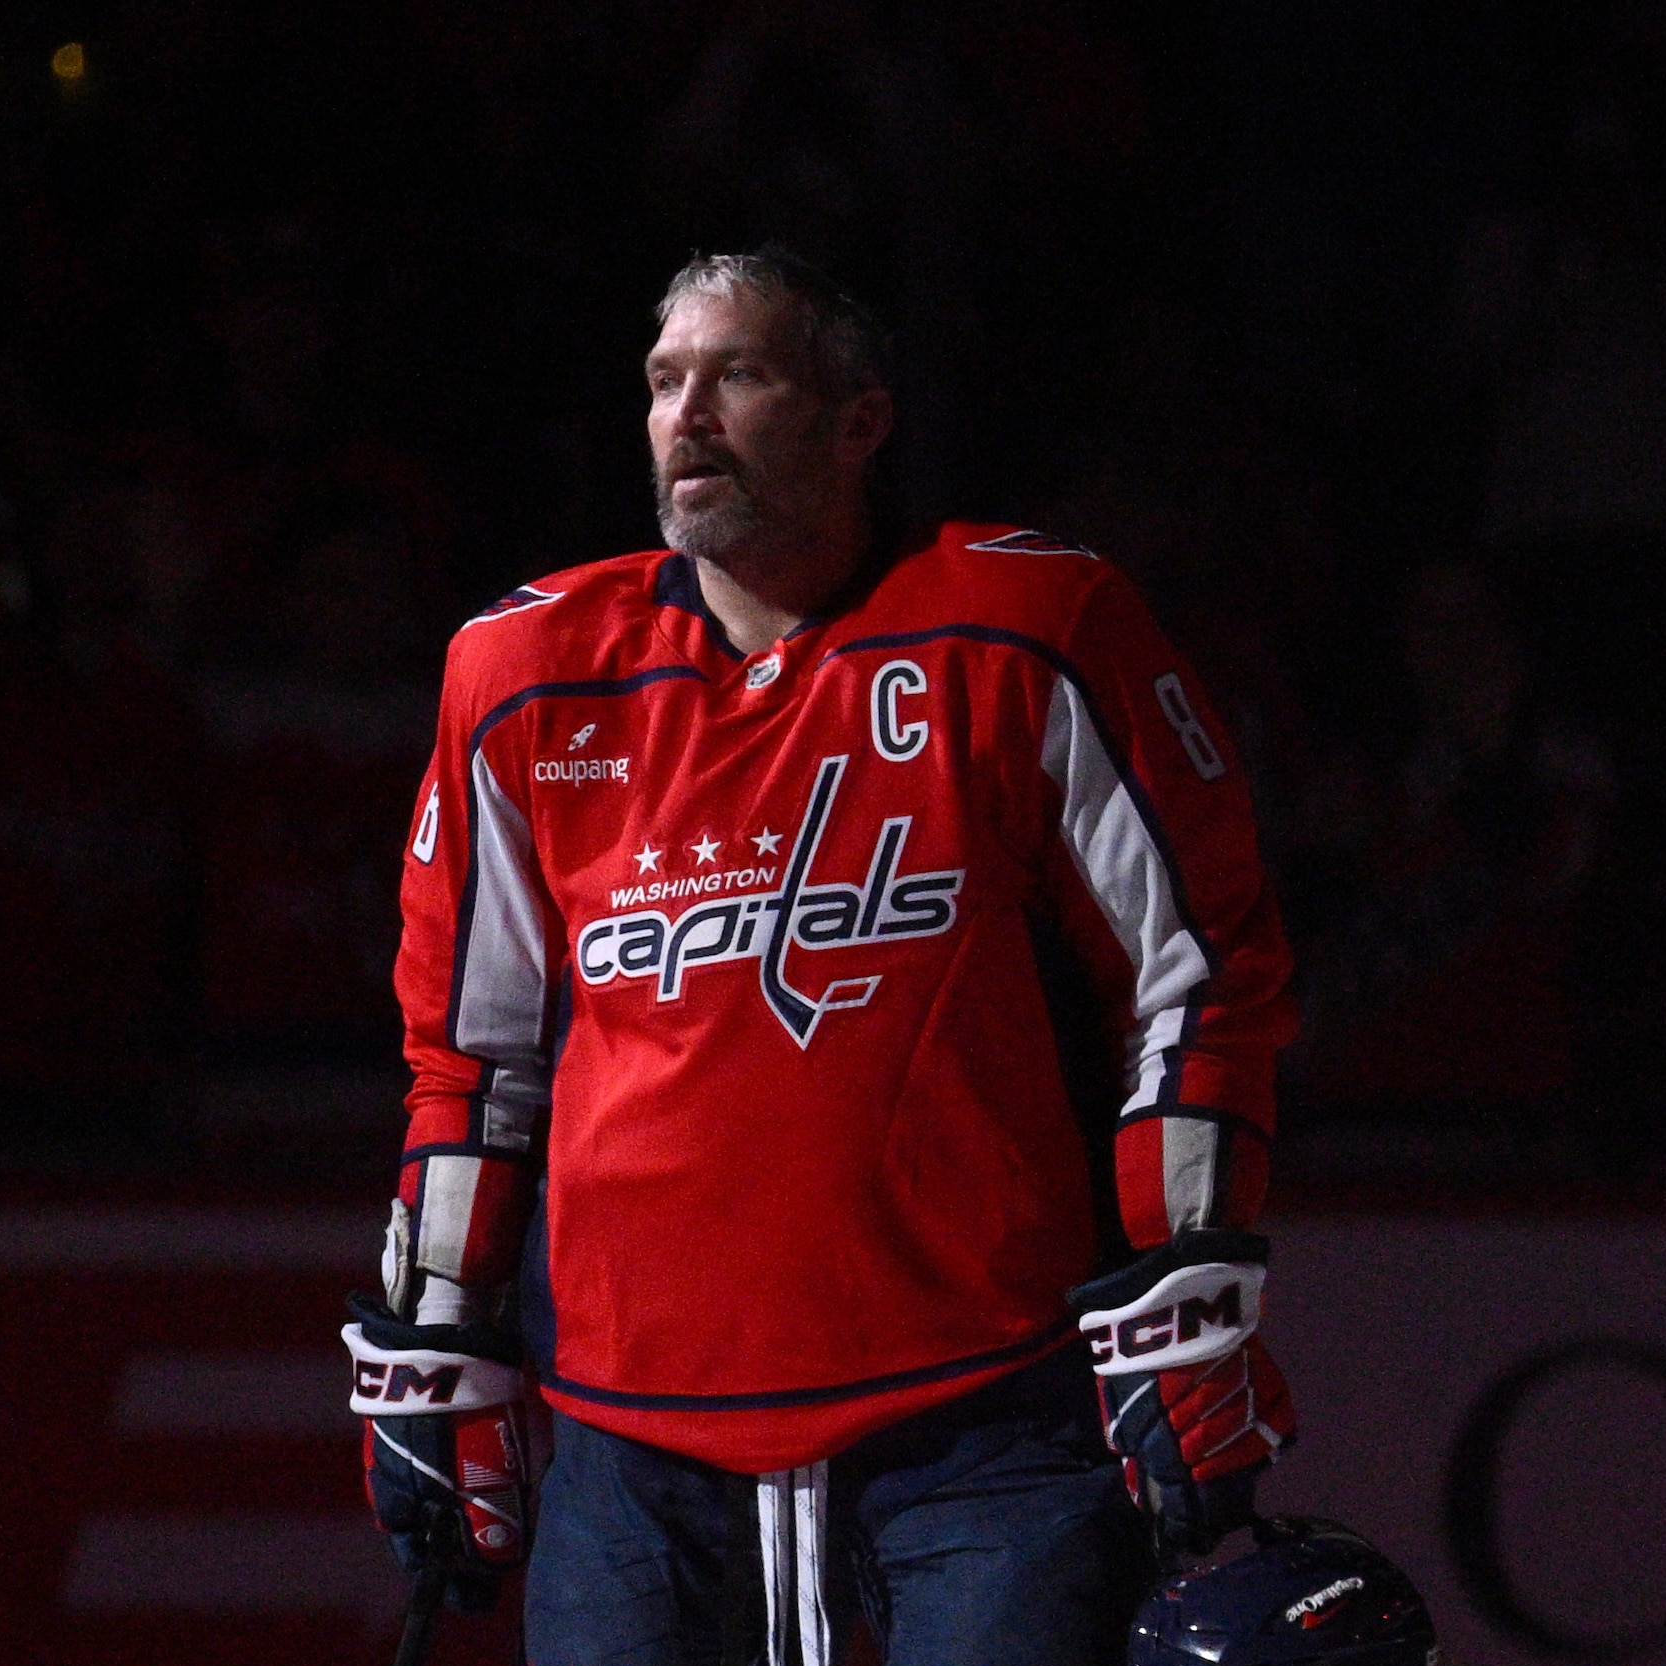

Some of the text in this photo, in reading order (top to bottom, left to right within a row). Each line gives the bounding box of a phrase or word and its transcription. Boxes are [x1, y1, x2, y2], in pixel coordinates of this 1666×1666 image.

[870, 659, 929, 763] C
[1154, 671, 1227, 783] 8
[534, 756, 630, 788] coupang
[610, 866, 778, 909] WASHINGTON
[1082, 1281, 1242, 1367] CCM
